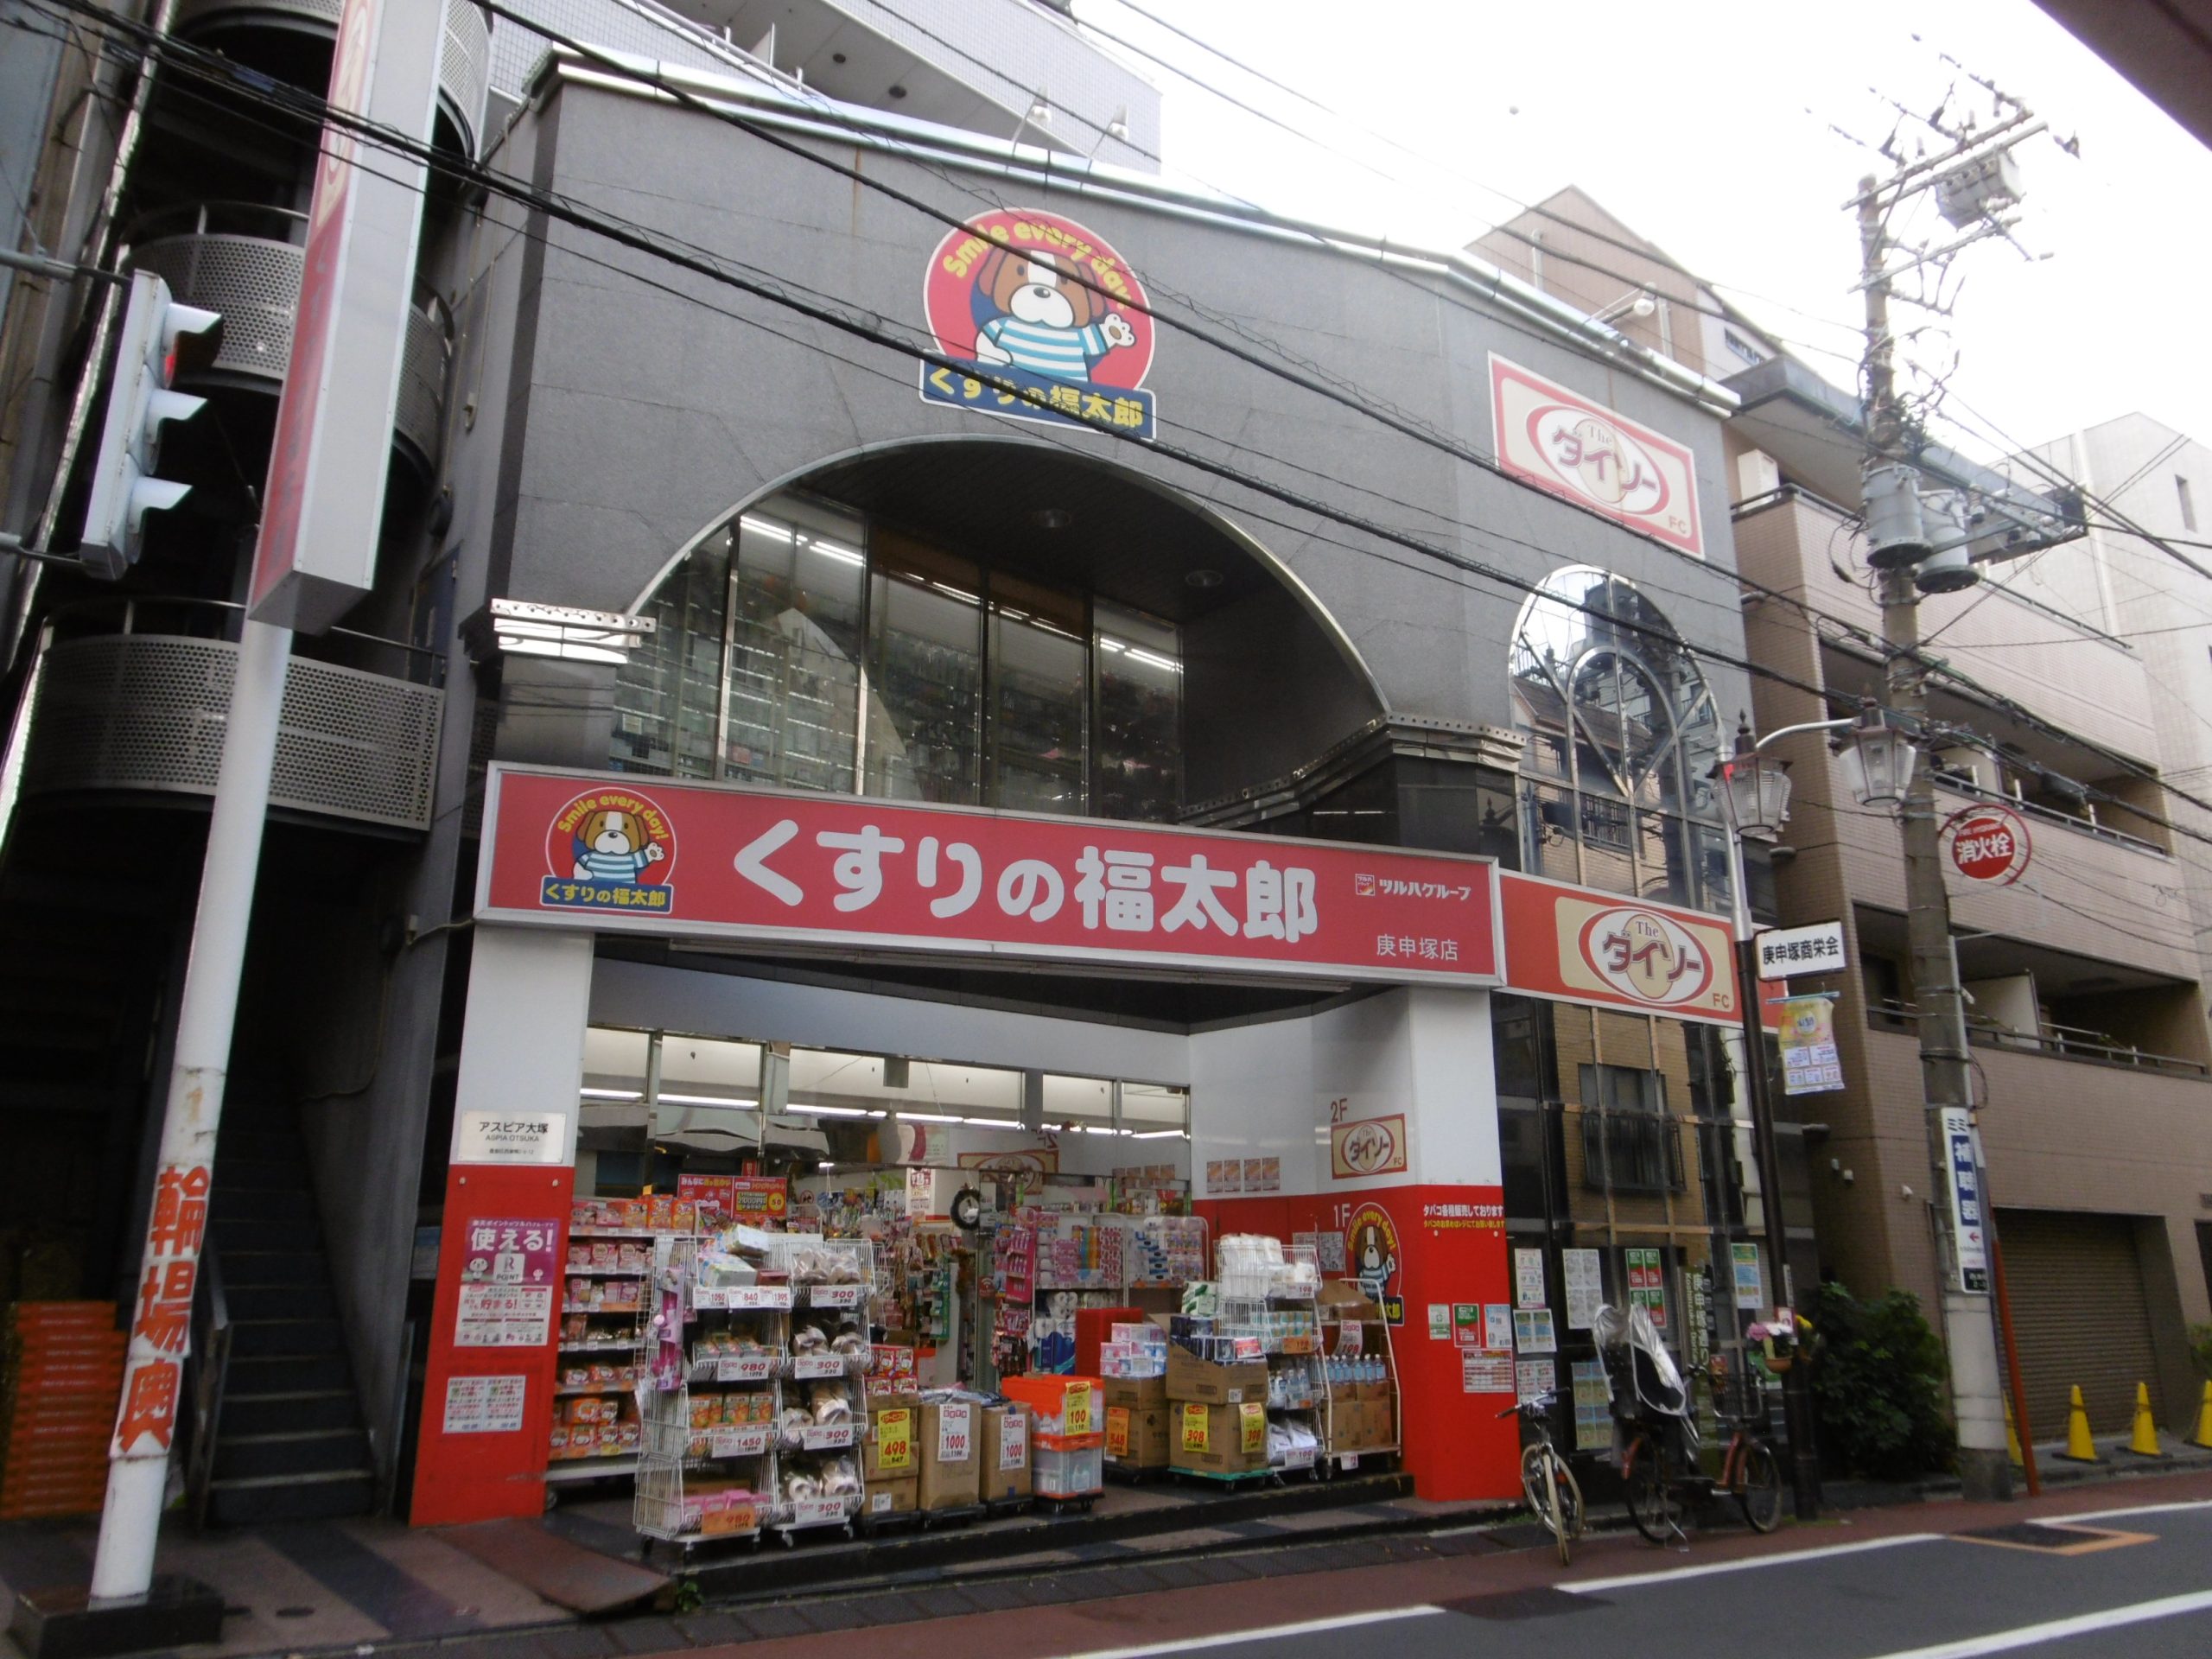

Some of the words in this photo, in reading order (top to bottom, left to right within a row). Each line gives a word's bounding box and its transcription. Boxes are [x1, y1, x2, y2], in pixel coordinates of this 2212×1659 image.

[1014, 221, 1092, 261] every
[1552, 423, 1657, 492] ダイソー
[1669, 515, 1687, 534] FC
[557, 798, 597, 833] Smile
[600, 795, 644, 815] every
[643, 809, 669, 840] day!
[1955, 832, 2012, 864] 消火栓
[734, 820, 1318, 943] くすりの福太郎
[1379, 879, 1471, 900] ツルハグループ
[545, 883, 665, 906] くすりの福太郎
[1636, 921, 1659, 938] The
[1376, 933, 1459, 961] 庚申塚店
[1602, 930, 1702, 982] ダイソー
[1763, 936, 1840, 965] 庚申塚商栄会
[1713, 992, 1730, 1008] FC
[1331, 1097, 1348, 1122] 2F
[480, 1122, 549, 1134] アスピア大塚
[1333, 1204, 1351, 1228] 1F
[1348, 1217, 1363, 1251] Smile
[1363, 1211, 1382, 1226] every
[1071, 1409, 1086, 1424] 100
[737, 1437, 761, 1447] 1450
[826, 1430, 849, 1439] 300
[945, 1435, 965, 1449] 1000
[884, 1440, 906, 1455] 498
[1006, 1444, 1022, 1458] 1000
